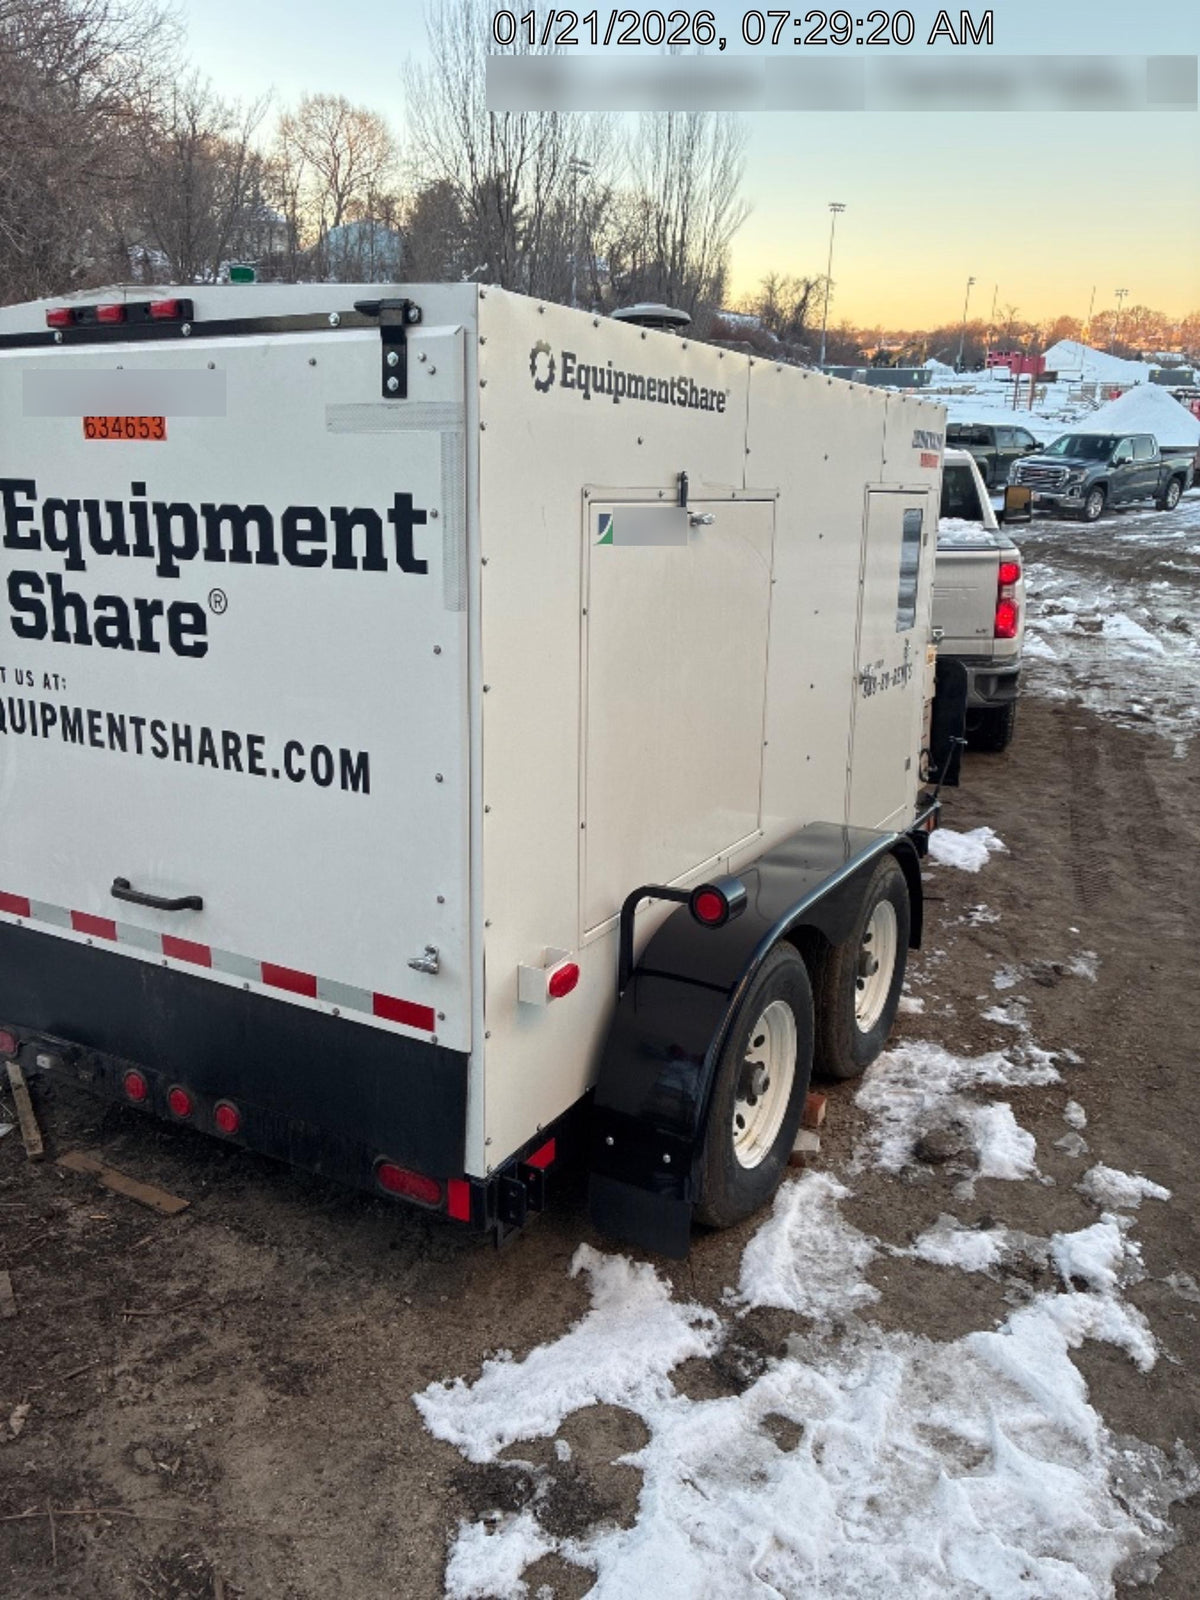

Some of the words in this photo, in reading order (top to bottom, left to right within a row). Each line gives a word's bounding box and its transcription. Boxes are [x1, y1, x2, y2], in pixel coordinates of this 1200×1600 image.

[560, 350, 726, 413] EquipmentShare
[86, 416, 165, 439] 634653
[0, 478, 428, 578] Equipment
[15, 667, 34, 687] US
[43, 672, 67, 691] AT:
